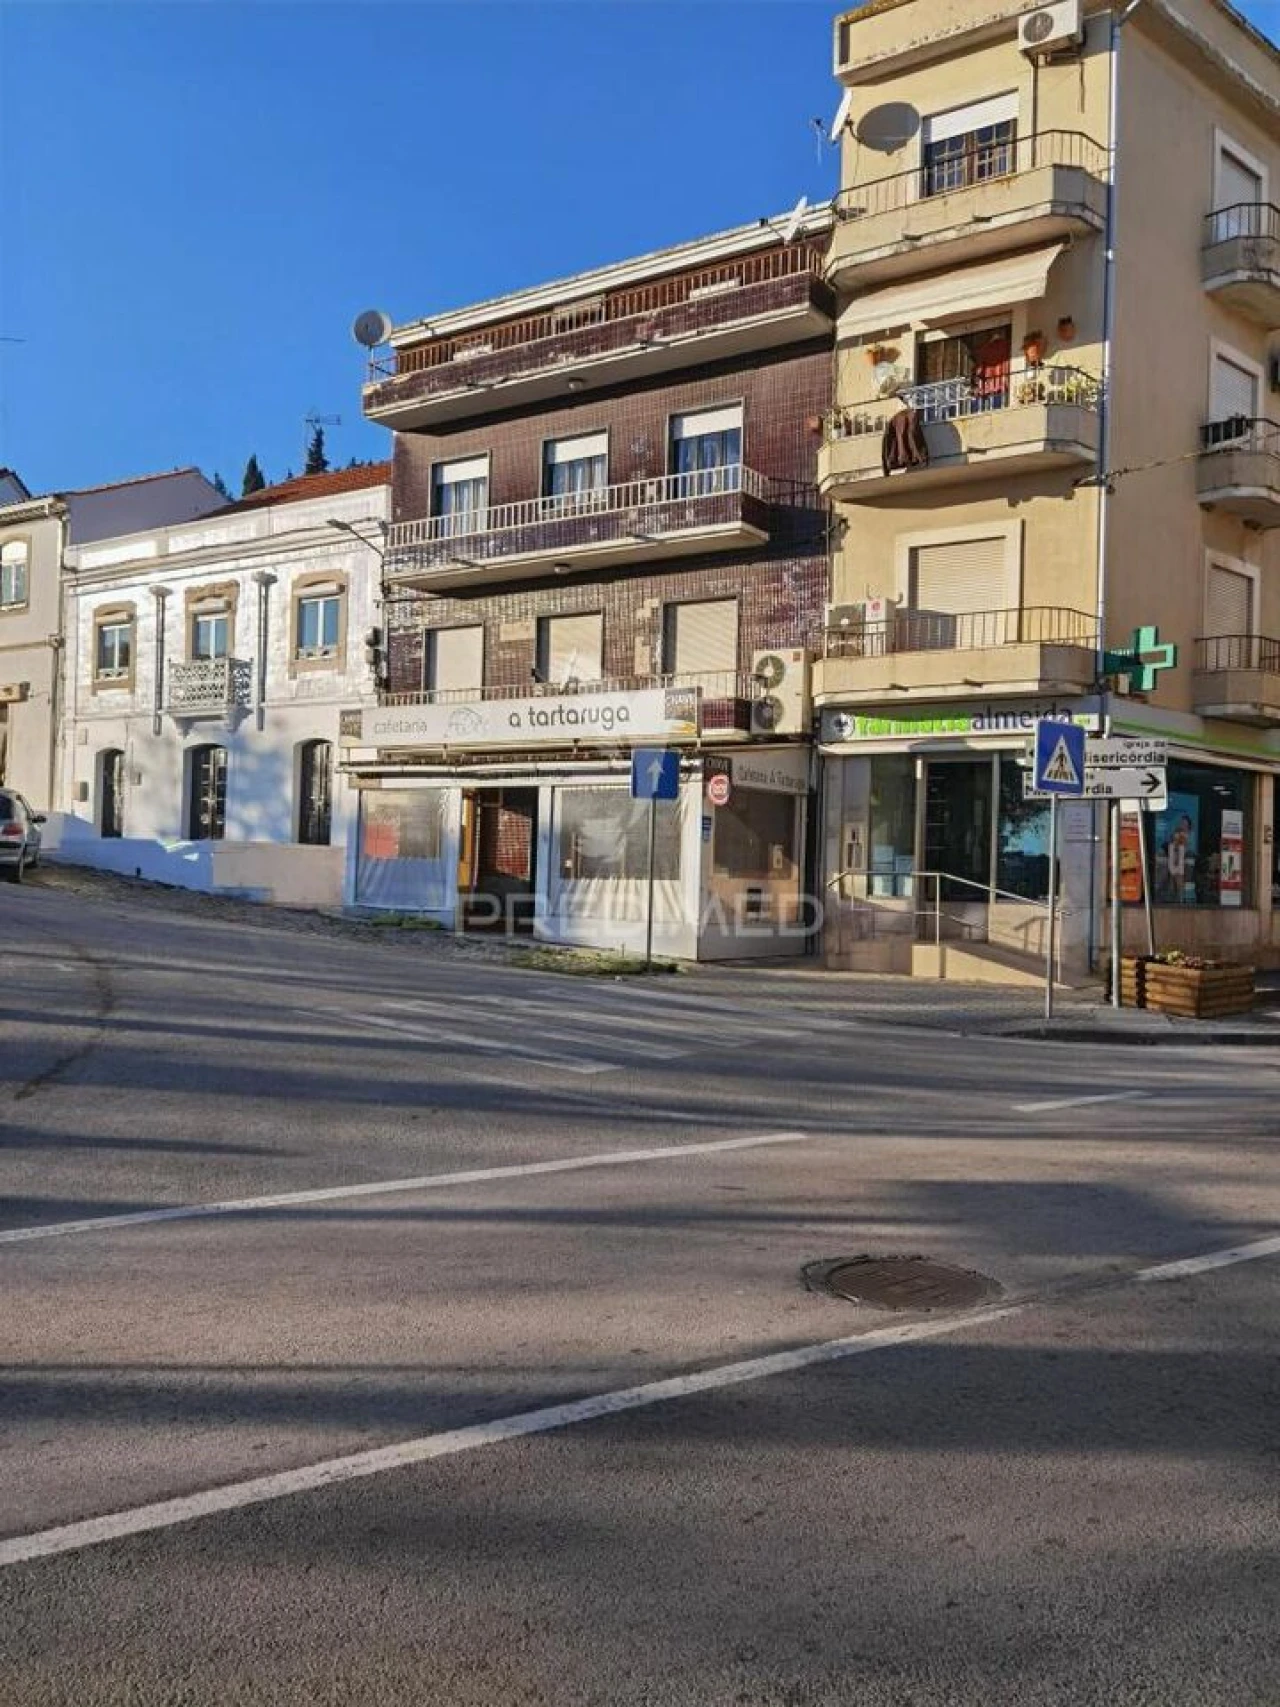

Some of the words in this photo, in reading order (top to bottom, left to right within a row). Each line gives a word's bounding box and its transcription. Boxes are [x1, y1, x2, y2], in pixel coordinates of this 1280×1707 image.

[509, 710, 522, 728] a
[528, 704, 631, 730] tartaruga
[972, 703, 1072, 730] almeida
